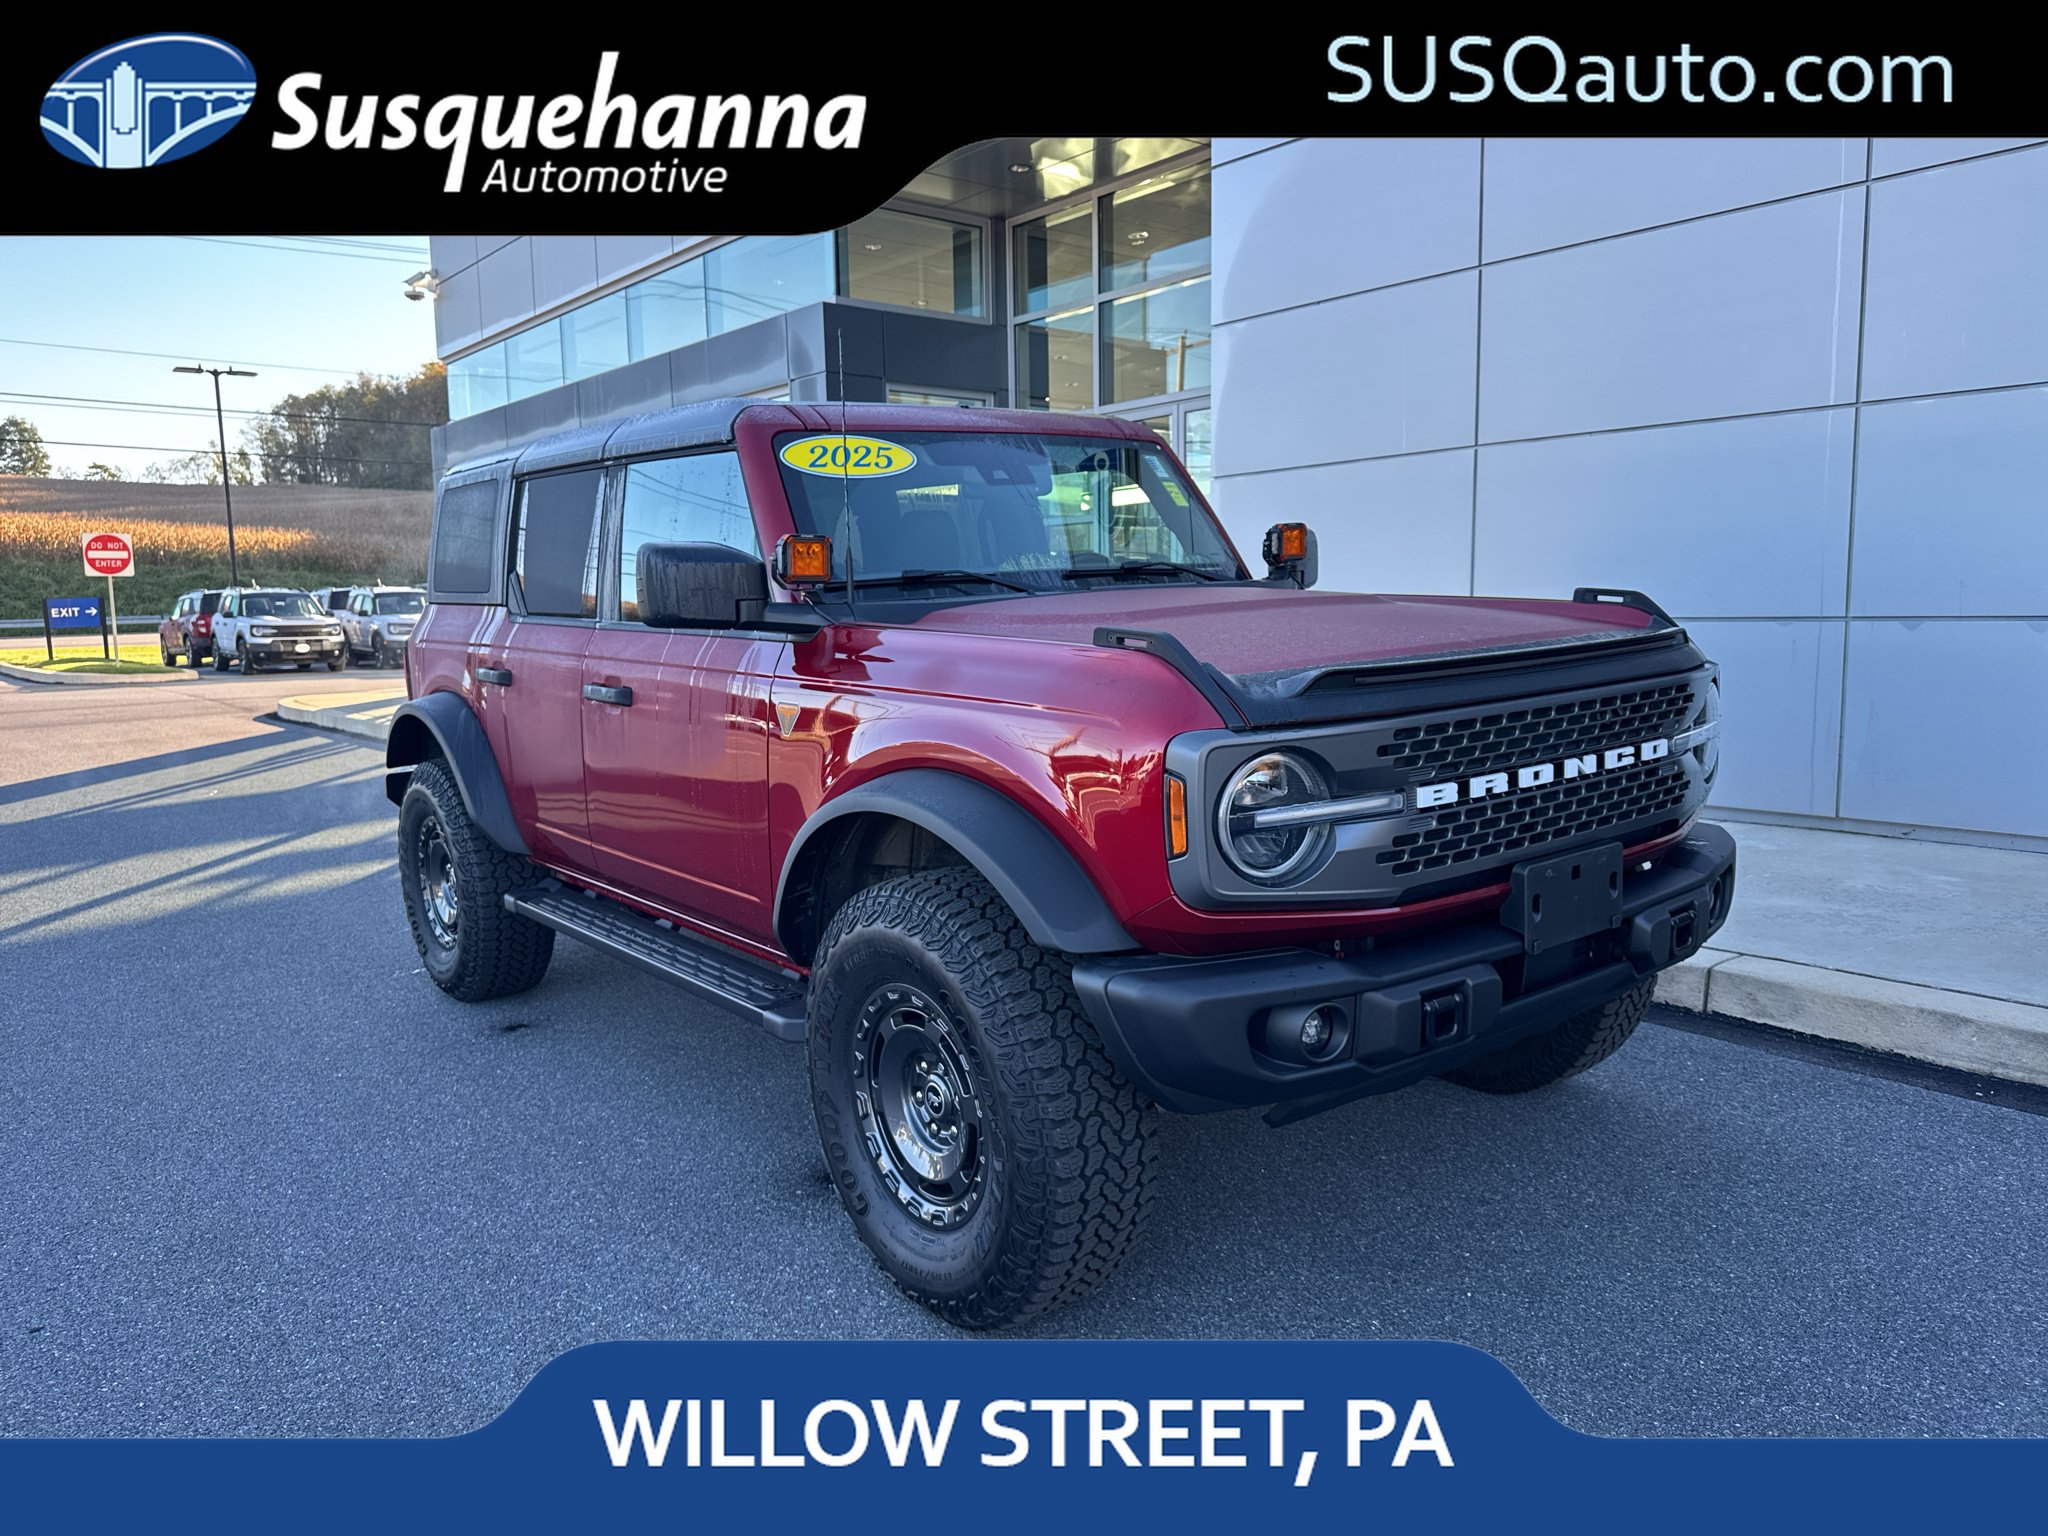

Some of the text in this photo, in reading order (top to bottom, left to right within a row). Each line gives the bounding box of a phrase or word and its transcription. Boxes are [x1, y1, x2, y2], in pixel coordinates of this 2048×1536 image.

[808, 445, 893, 469] 2025
[90, 541, 102, 549] DO
[50, 607, 80, 618] EXIT
[1416, 738, 1668, 808] BRONCO
